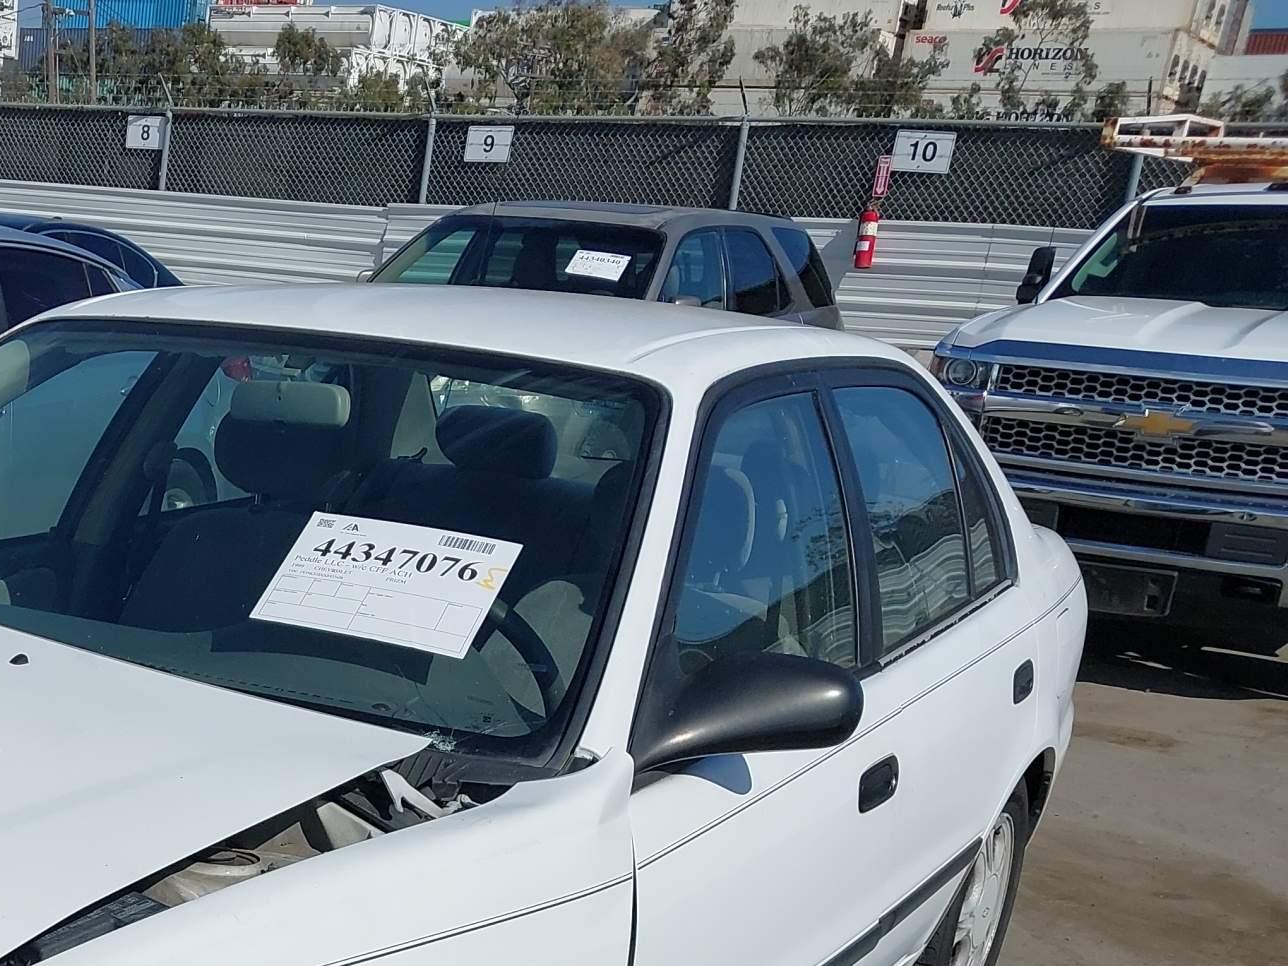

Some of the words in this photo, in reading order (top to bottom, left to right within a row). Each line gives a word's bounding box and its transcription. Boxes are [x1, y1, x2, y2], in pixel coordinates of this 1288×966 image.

[1006, 47, 1089, 61] HORIZON
[140, 124, 151, 141] 8
[482, 134, 495, 153] 9
[909, 140, 938, 163] 10
[294, 554, 323, 565] Peddle
[324, 558, 345, 567] LLC
[388, 569, 413, 579] ACH
[312, 538, 485, 582] 44347076
